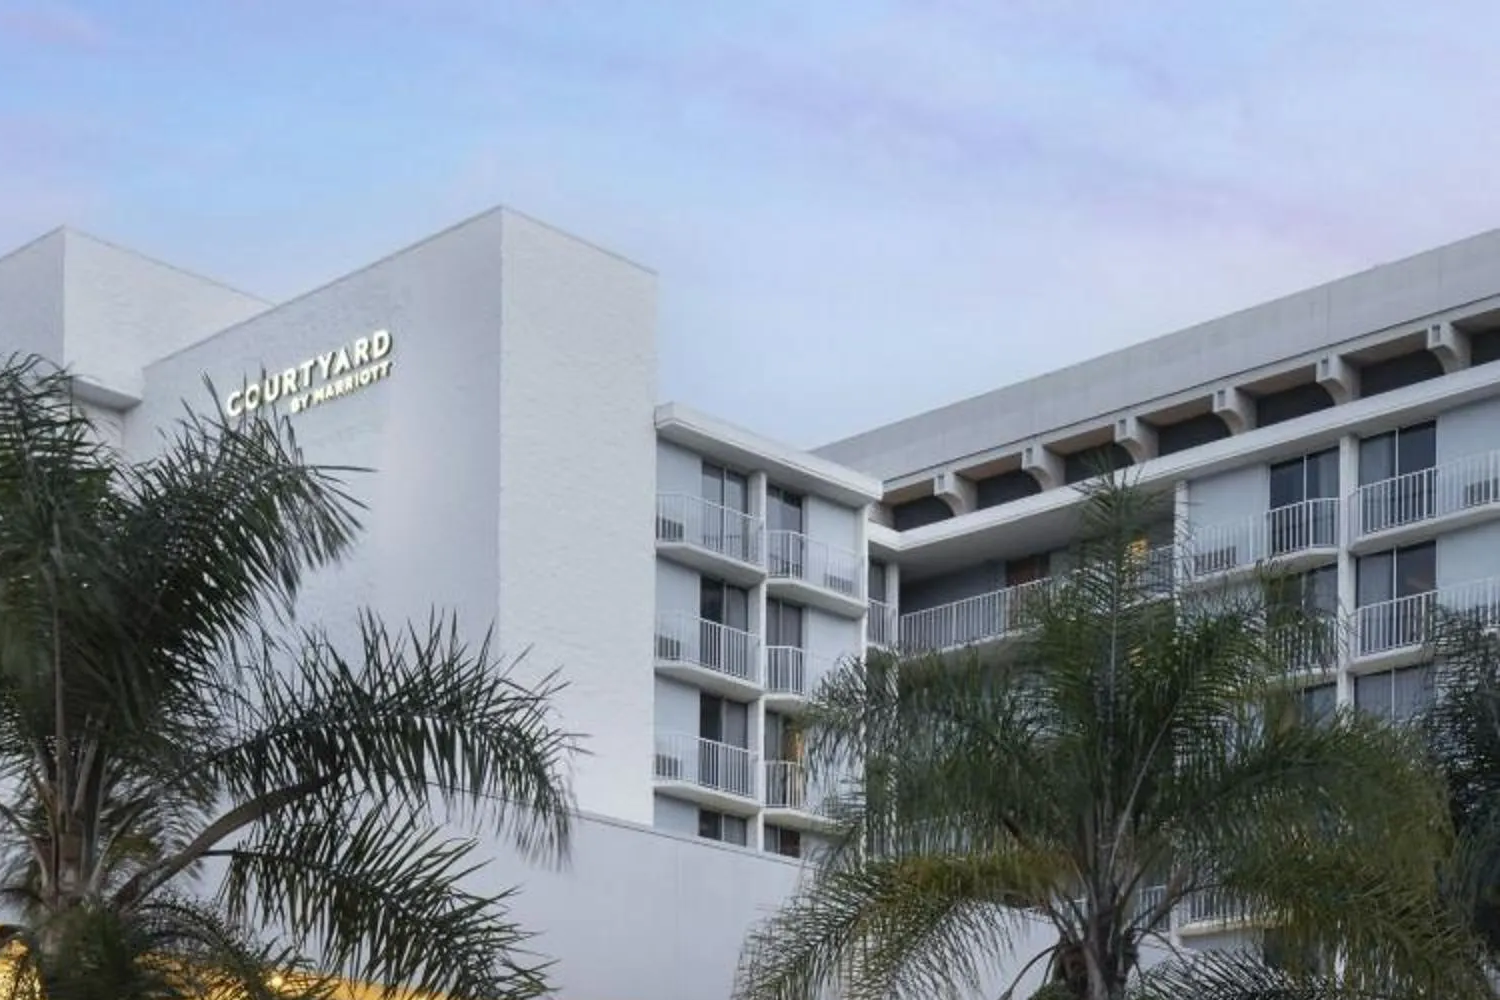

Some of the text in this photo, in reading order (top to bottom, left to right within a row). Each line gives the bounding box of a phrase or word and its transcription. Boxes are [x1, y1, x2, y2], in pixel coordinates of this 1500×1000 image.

[227, 329, 393, 417] COURTYARD
[290, 361, 392, 414] BY MARRIOTT
